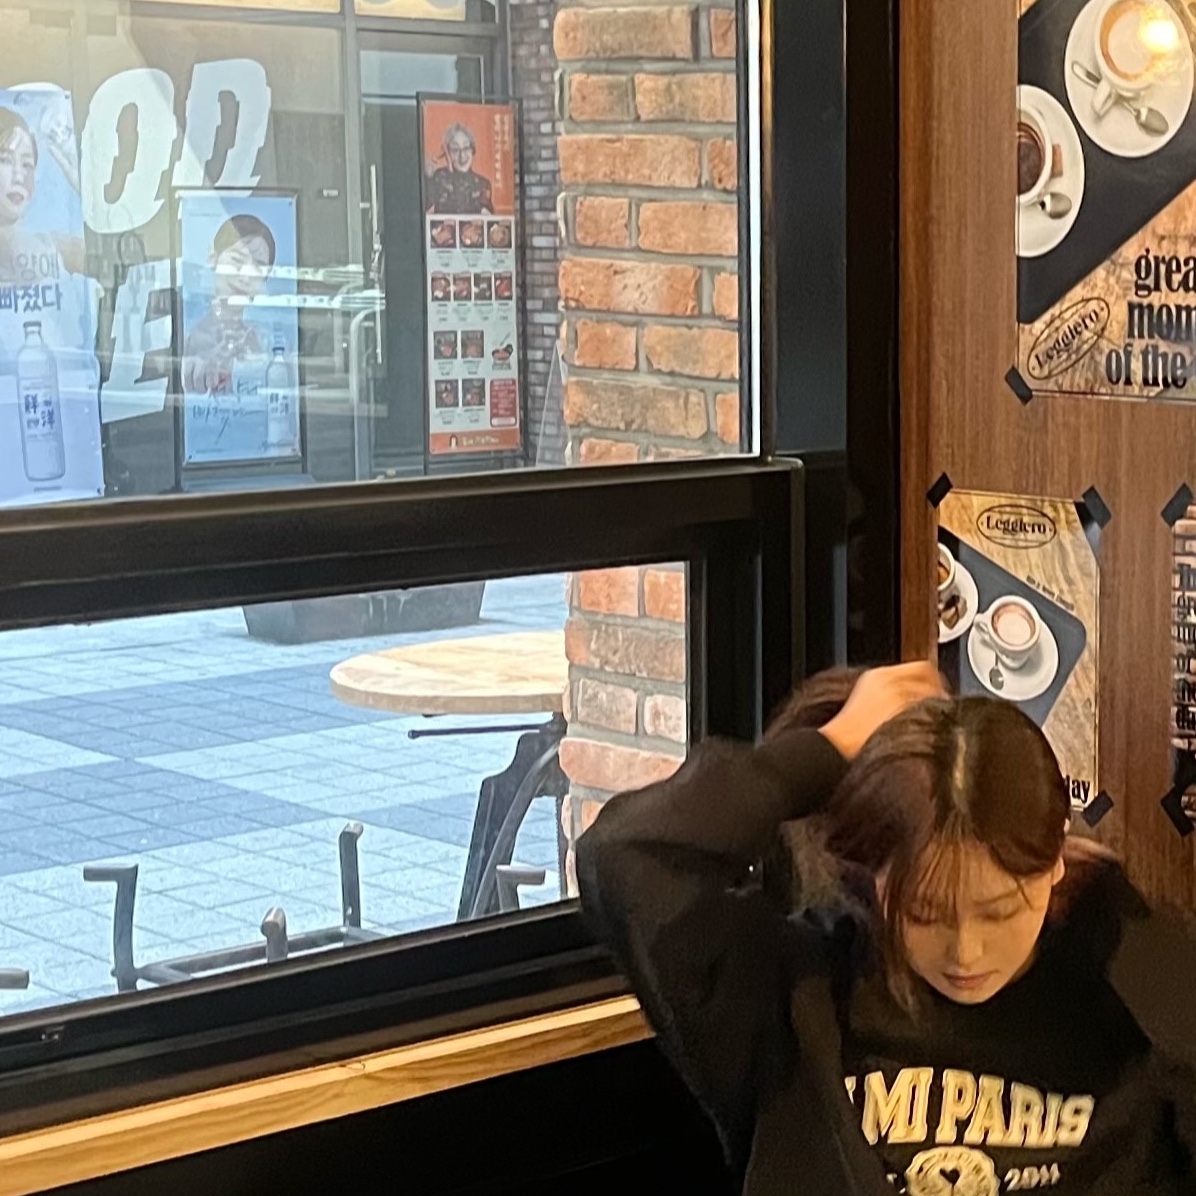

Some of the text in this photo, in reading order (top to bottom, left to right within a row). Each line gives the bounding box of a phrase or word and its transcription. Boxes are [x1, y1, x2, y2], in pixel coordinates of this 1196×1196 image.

[1033, 307, 1100, 370] Leggiero
[1105, 343, 1134, 388] of
[1140, 343, 1188, 390] the
[986, 515, 1047, 537] Leggiero
[935, 1068, 1096, 1149] PARIS
